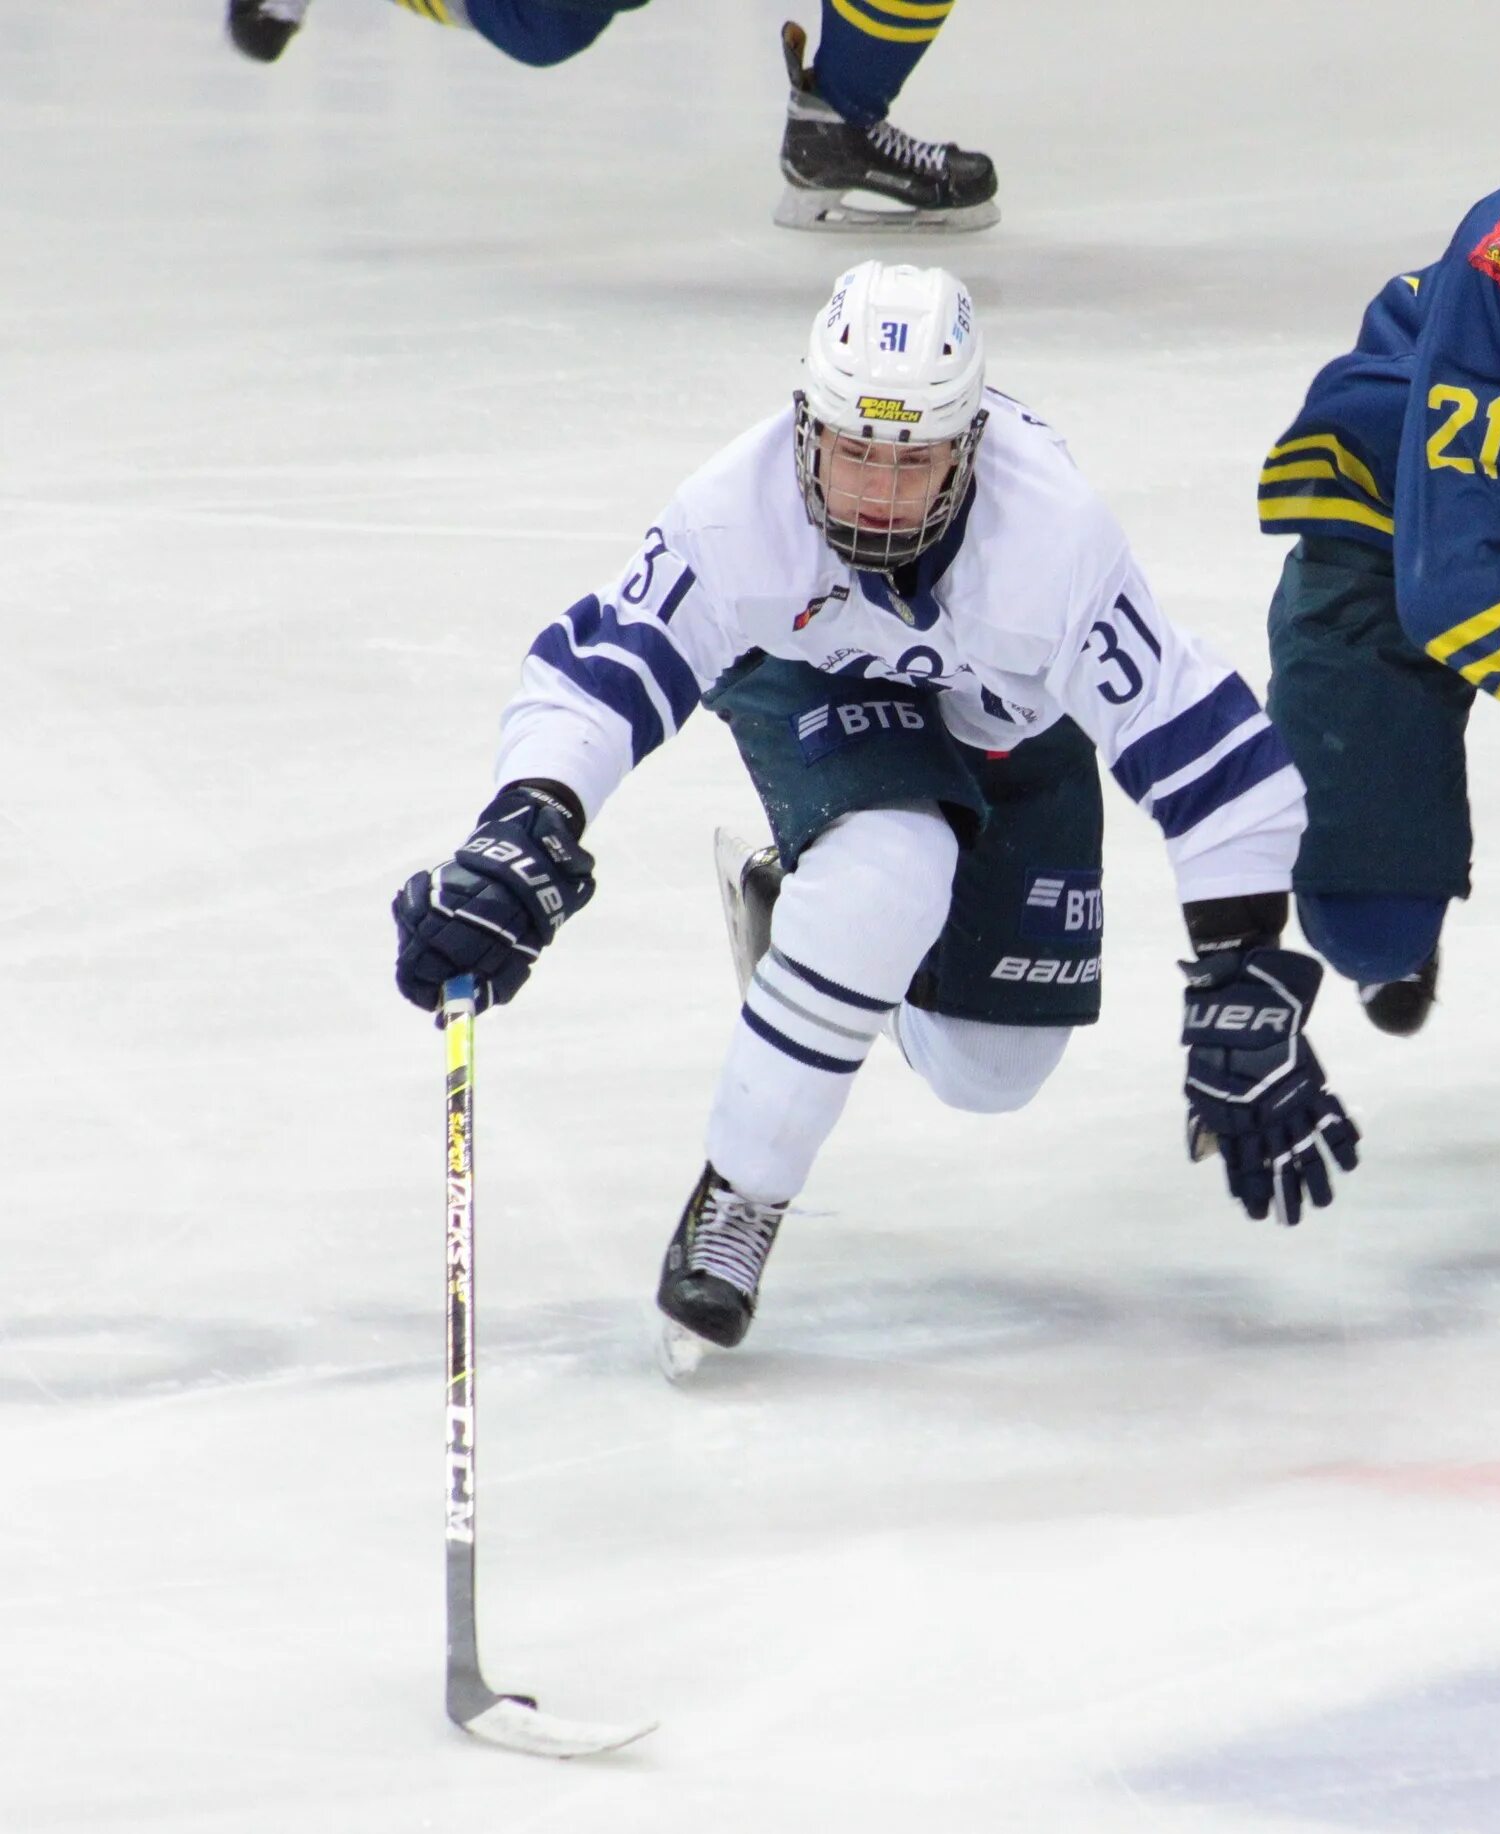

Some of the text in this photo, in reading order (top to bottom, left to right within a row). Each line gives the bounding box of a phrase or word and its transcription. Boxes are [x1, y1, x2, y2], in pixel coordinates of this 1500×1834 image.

[879, 321, 909, 353] 31
[860, 397, 903, 412] PARI
[863, 408, 921, 422] MATCH
[622, 526, 697, 626] 31
[1081, 592, 1162, 705] 31
[836, 700, 925, 735] ВТБ
[446, 1404, 474, 1544] CCM
